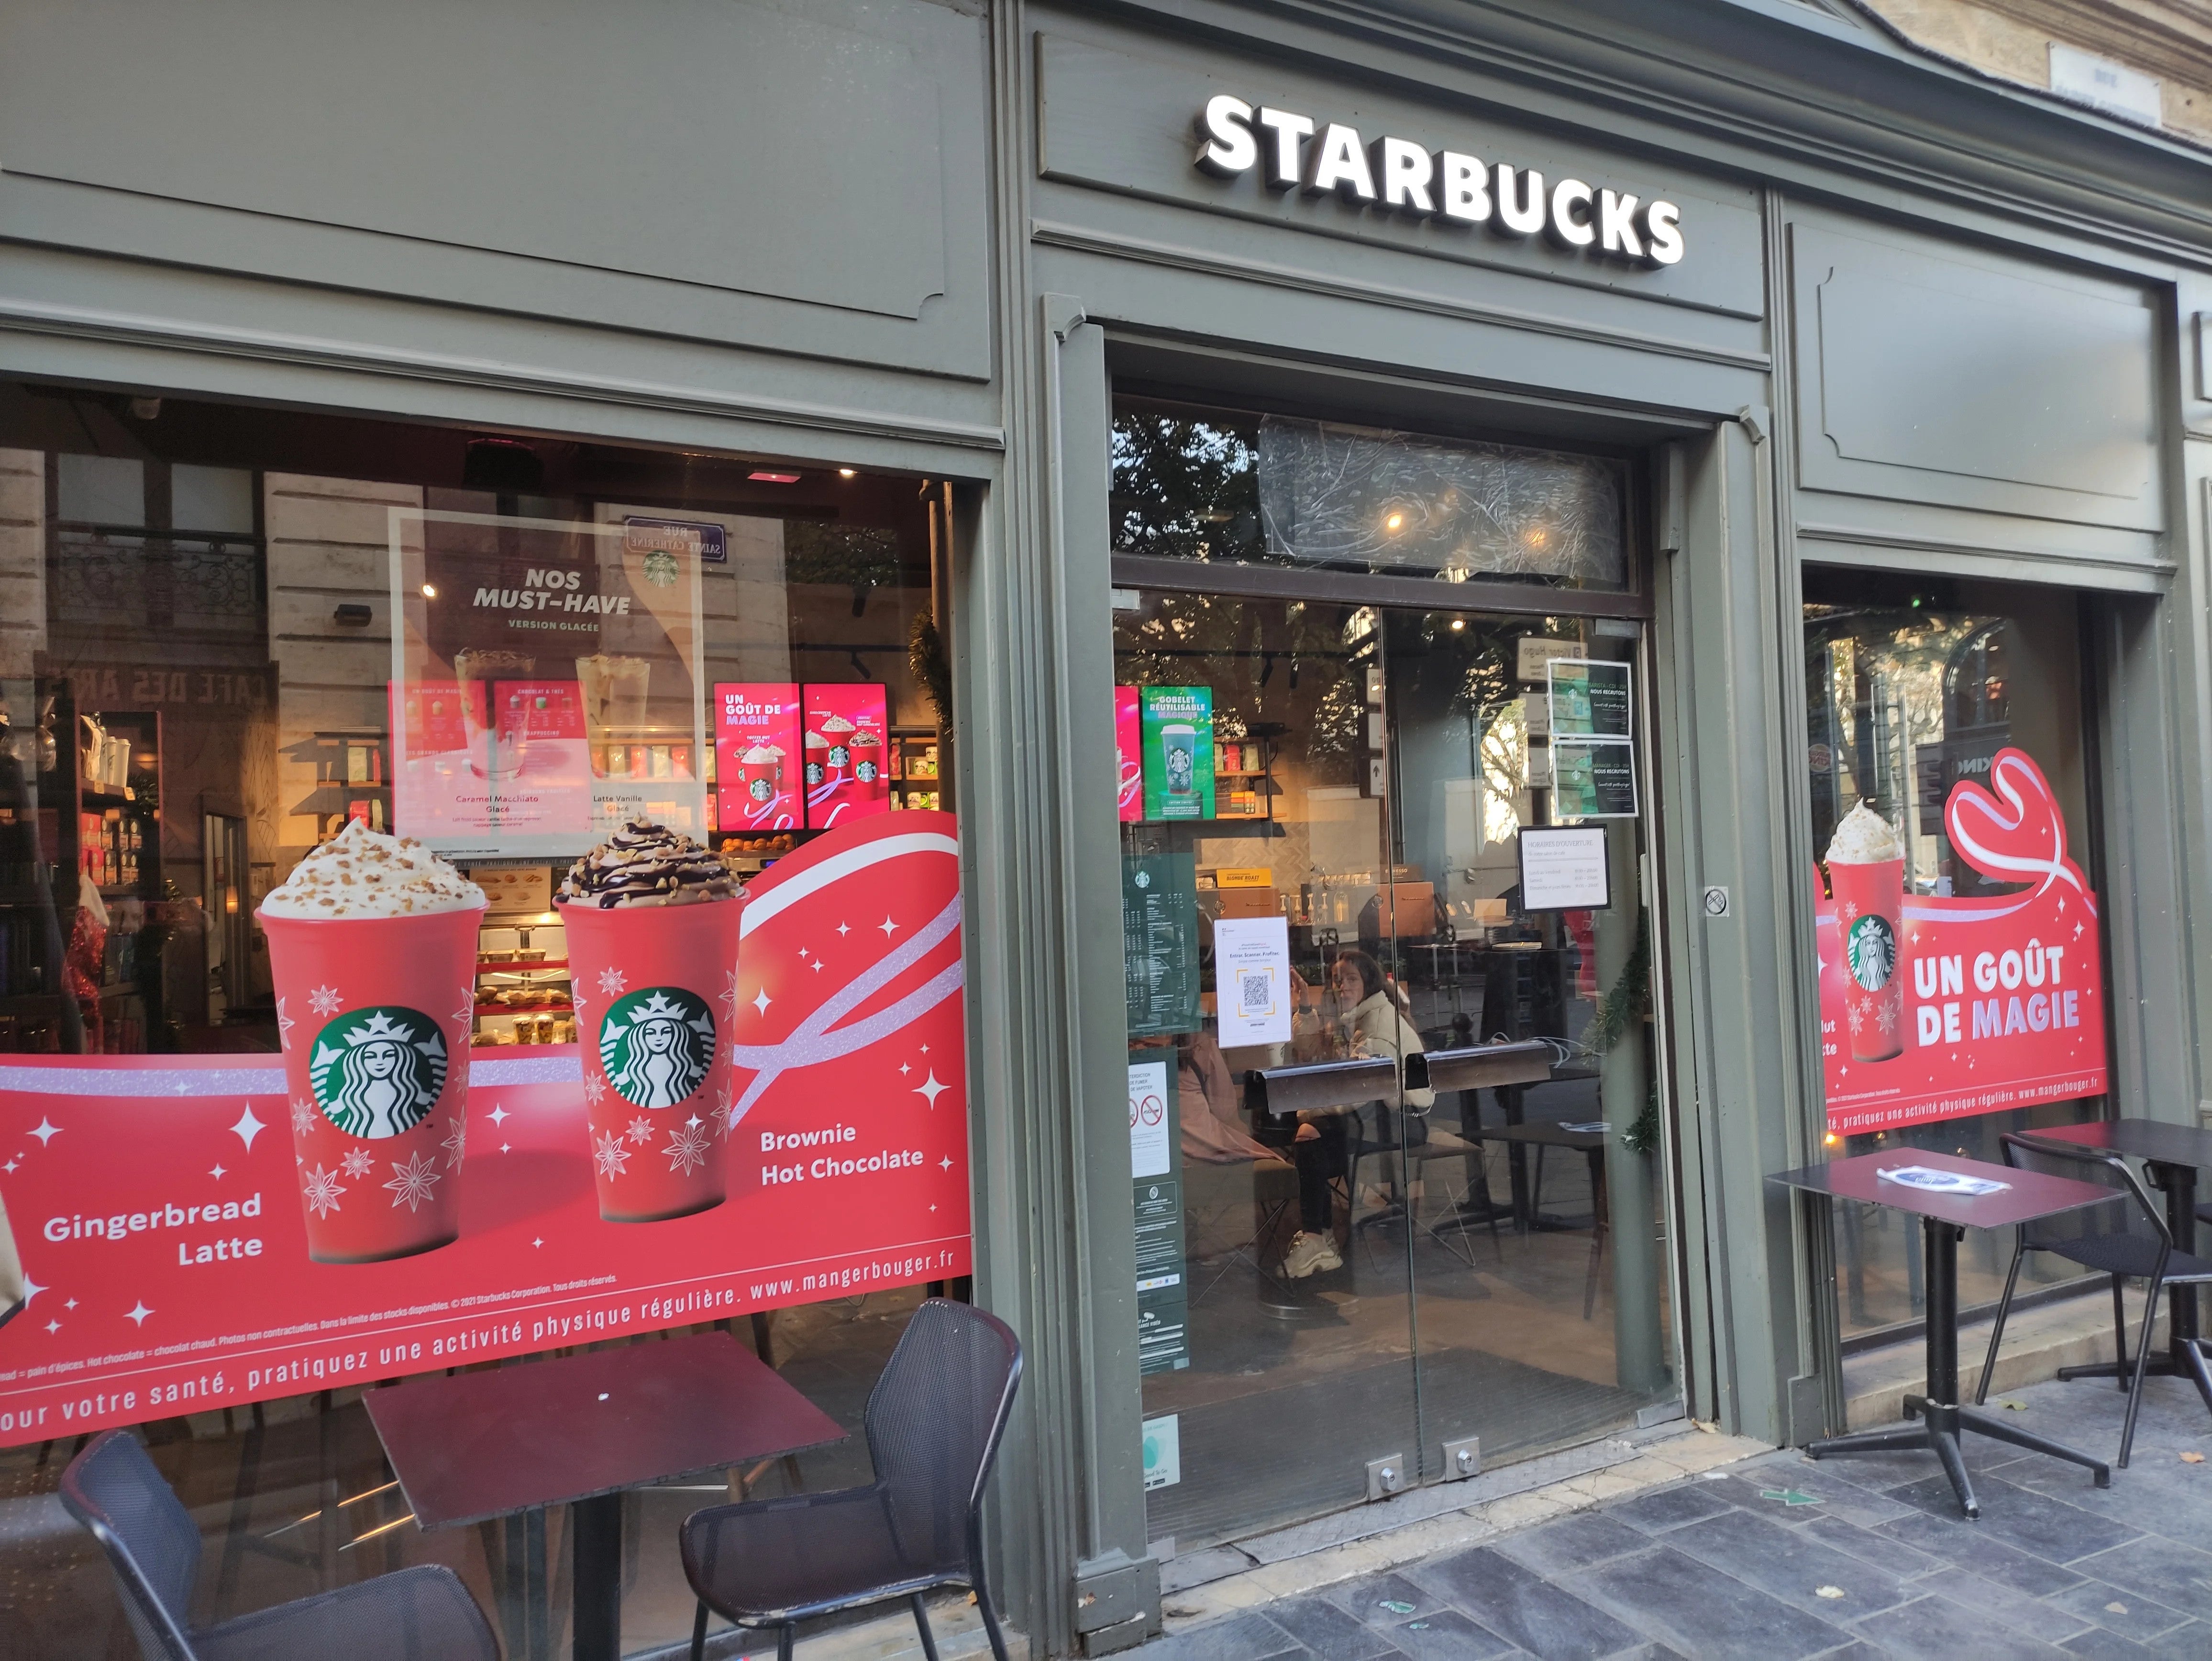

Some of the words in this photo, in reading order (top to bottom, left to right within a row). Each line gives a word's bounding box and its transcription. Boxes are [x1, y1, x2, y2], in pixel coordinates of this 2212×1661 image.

[1201, 94, 1685, 268] STARBUCKS
[525, 568, 581, 590] NOS
[473, 587, 631, 615] MUST-HAVE
[508, 620, 556, 630] VERSION
[559, 621, 599, 632] GLACÉE
[725, 694, 744, 705] UN
[725, 702, 762, 715] GOÛT
[764, 704, 781, 715] DE
[1150, 702, 1206, 711] RÉUTILISABLE
[726, 715, 769, 725] MAGIE
[486, 805, 510, 813] Glacé
[494, 795, 539, 803] Macchiato
[1913, 953, 1963, 999] UN
[1972, 937, 2064, 993] GOÛT
[1916, 1001, 1961, 1047] DE
[1972, 989, 2079, 1041] MAGIE
[1843, 1111, 1884, 1130] pratiquez
[1887, 1108, 1902, 1121] une
[1905, 1101, 1937, 1118] activité
[1939, 1096, 1976, 1115] physique
[1978, 1090, 2016, 1107] régulière.
[2018, 1076, 2098, 1100] www.mangerbouger.fr
[760, 1122, 856, 1152] Brownie
[762, 1163, 804, 1186] Hot
[810, 1149, 924, 1179] Chocolate
[44, 1192, 261, 1242] Gingerbread
[178, 1237, 263, 1266] Latte
[27, 1365, 47, 1379] pain
[47, 1360, 84, 1374] d'épices.
[87, 1357, 103, 1368] Hot
[103, 1350, 145, 1364] chocolate
[154, 1341, 190, 1357] chocolat
[190, 1338, 218, 1351] chaud.
[219, 1333, 246, 1346] Photos
[247, 1331, 262, 1341] non
[263, 1321, 318, 1339] contractuelles.
[320, 1319, 339, 1329] Dans
[340, 1317, 347, 1326] la
[347, 1313, 368, 1325] limite
[369, 1311, 383, 1321] des
[384, 1307, 407, 1319] stocks
[476, 1291, 511, 1305] Starbucks
[511, 1285, 552, 1299] Corporation.
[553, 1283, 568, 1292] Tous
[568, 1279, 587, 1290] droits
[588, 1274, 617, 1286] réservés.
[62, 1390, 136, 1420] votre
[150, 1370, 235, 1405] santé,
[247, 1351, 368, 1392] pratiquez
[379, 1341, 421, 1365] une
[432, 1320, 522, 1356] activité
[532, 1306, 630, 1342] physique
[641, 1287, 741, 1319] régulière.
[750, 1250, 954, 1301] www.mangerbouger.fr
